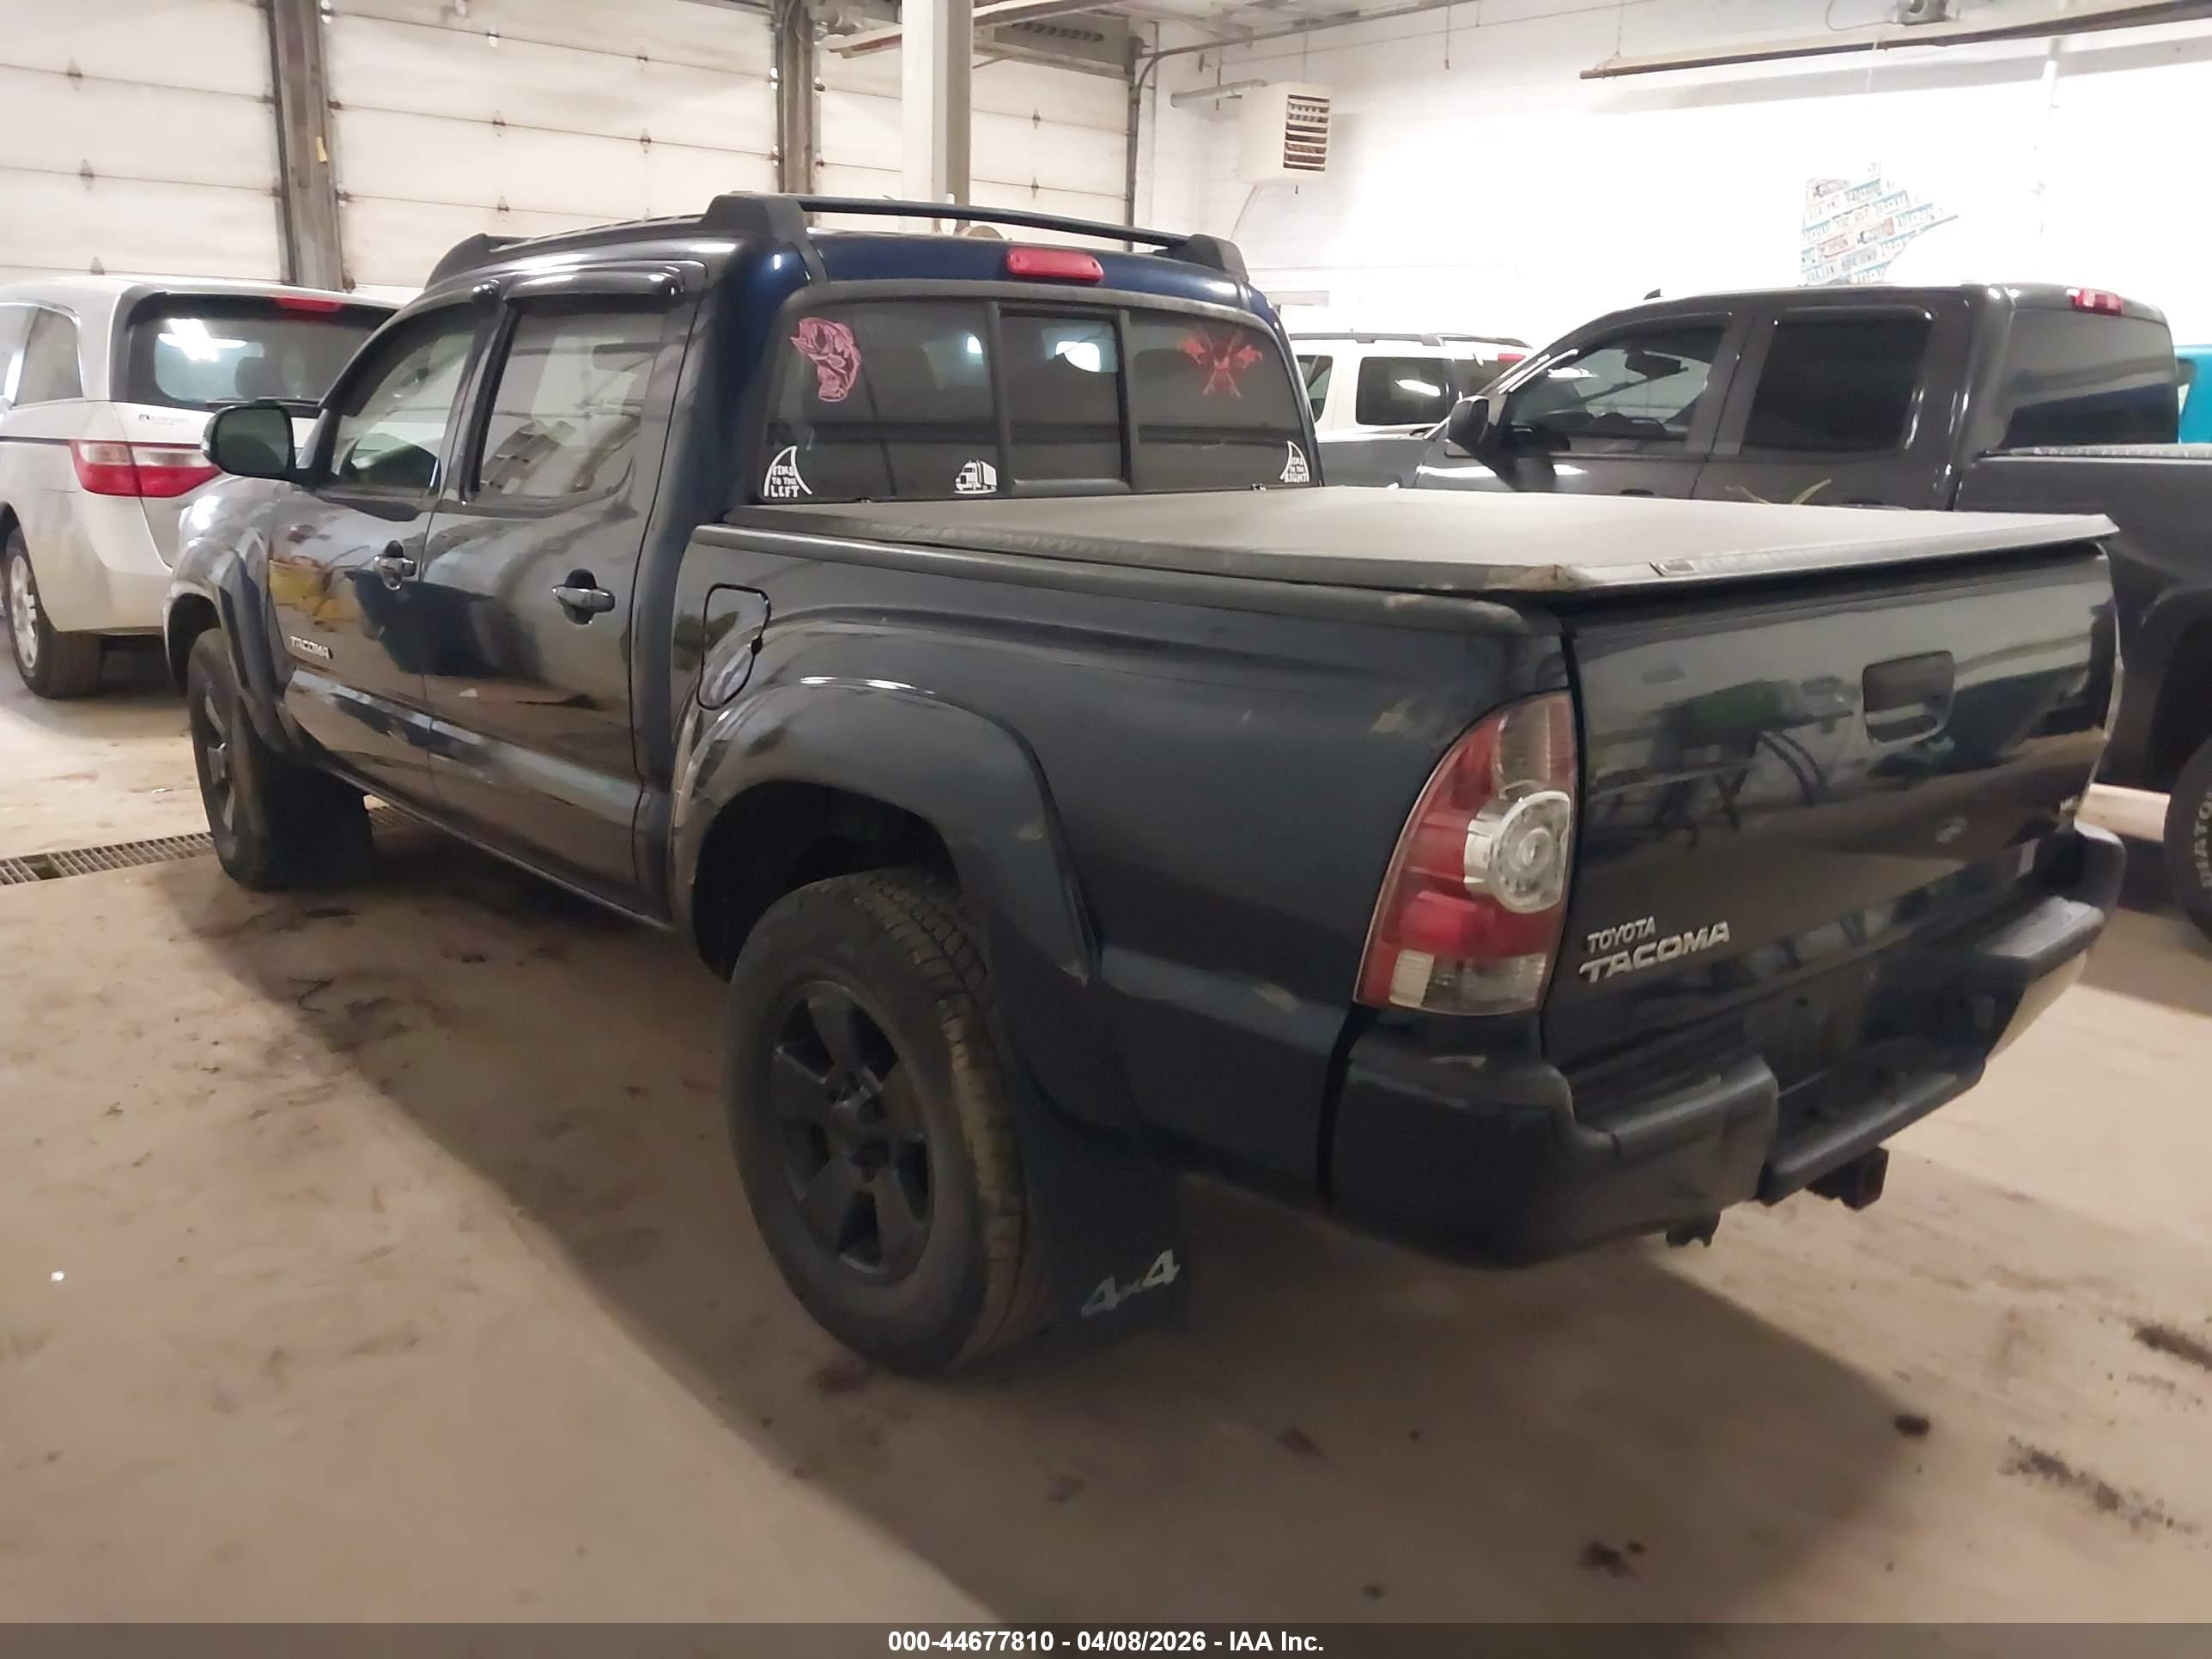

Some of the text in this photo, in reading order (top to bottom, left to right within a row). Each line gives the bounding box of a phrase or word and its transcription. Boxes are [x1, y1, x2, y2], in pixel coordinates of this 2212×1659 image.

[770, 485, 799, 497] LEFT
[771, 477, 781, 485] TO
[289, 635, 331, 659] TACOMA
[1587, 916, 1656, 955] TOYOTA
[1578, 921, 1731, 983] TACOMA
